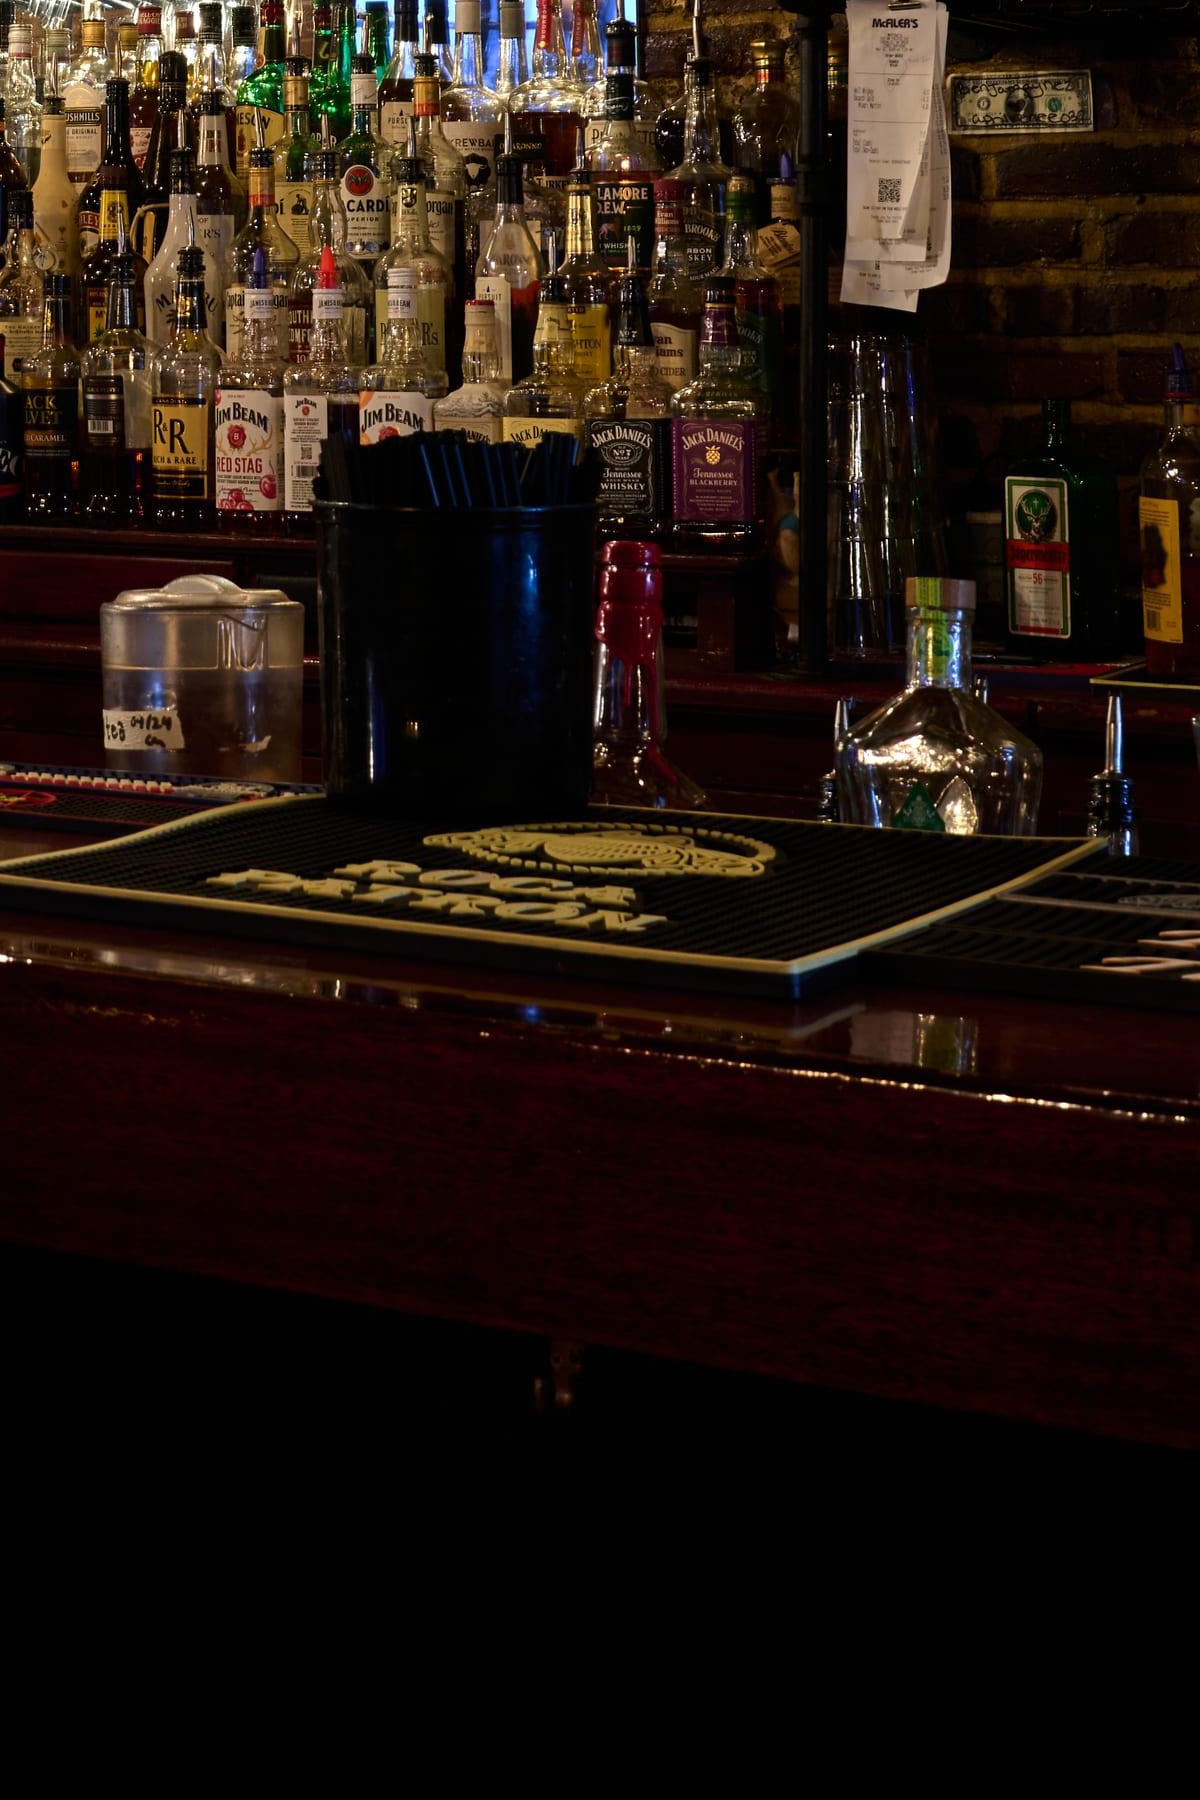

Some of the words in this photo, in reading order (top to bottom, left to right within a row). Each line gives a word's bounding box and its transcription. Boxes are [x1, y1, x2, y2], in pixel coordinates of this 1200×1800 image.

[65, 111, 100, 122] USHMILLS
[71, 128, 98, 136] ORIGINAL
[450, 138, 495, 147] KREWBA
[500, 142, 543, 151] DARONNO
[597, 187, 649, 200] LAMORE
[347, 196, 390, 213] CARDÍ
[426, 200, 453, 216] organ
[684, 224, 722, 242] BROOKS
[604, 242, 641, 250] WHISY
[688, 255, 713, 263] SKEY
[660, 367, 686, 377] CIDER
[25, 395, 58, 410] ACK
[295, 400, 304, 409] JIM
[303, 397, 318, 409] BEAM
[24, 410, 63, 425] LVET
[215, 407, 231, 428] JIM
[232, 401, 269, 433] BEAM
[361, 409, 383, 433] JIM
[384, 402, 425, 434] BEAM
[29, 433, 65, 443] CARAMEL
[233, 432, 240, 441] B
[510, 428, 532, 443] JACK
[591, 429, 615, 449] JACK
[614, 425, 654, 449] DANIEL'S
[681, 432, 706, 451] JACK
[706, 427, 746, 452] DANIEL'S
[153, 455, 165, 465] ICH
[174, 455, 197, 465] RARE
[216, 455, 232, 473] RED
[234, 457, 263, 474] STAG
[602, 467, 643, 479] Tennessee
[692, 467, 735, 479] Tennessee
[600, 482, 646, 491] WHISKEY
[689, 478, 738, 487] BLACKBERRY
[1032, 572, 1044, 585] 56
[130, 713, 172, 731] 04/24
